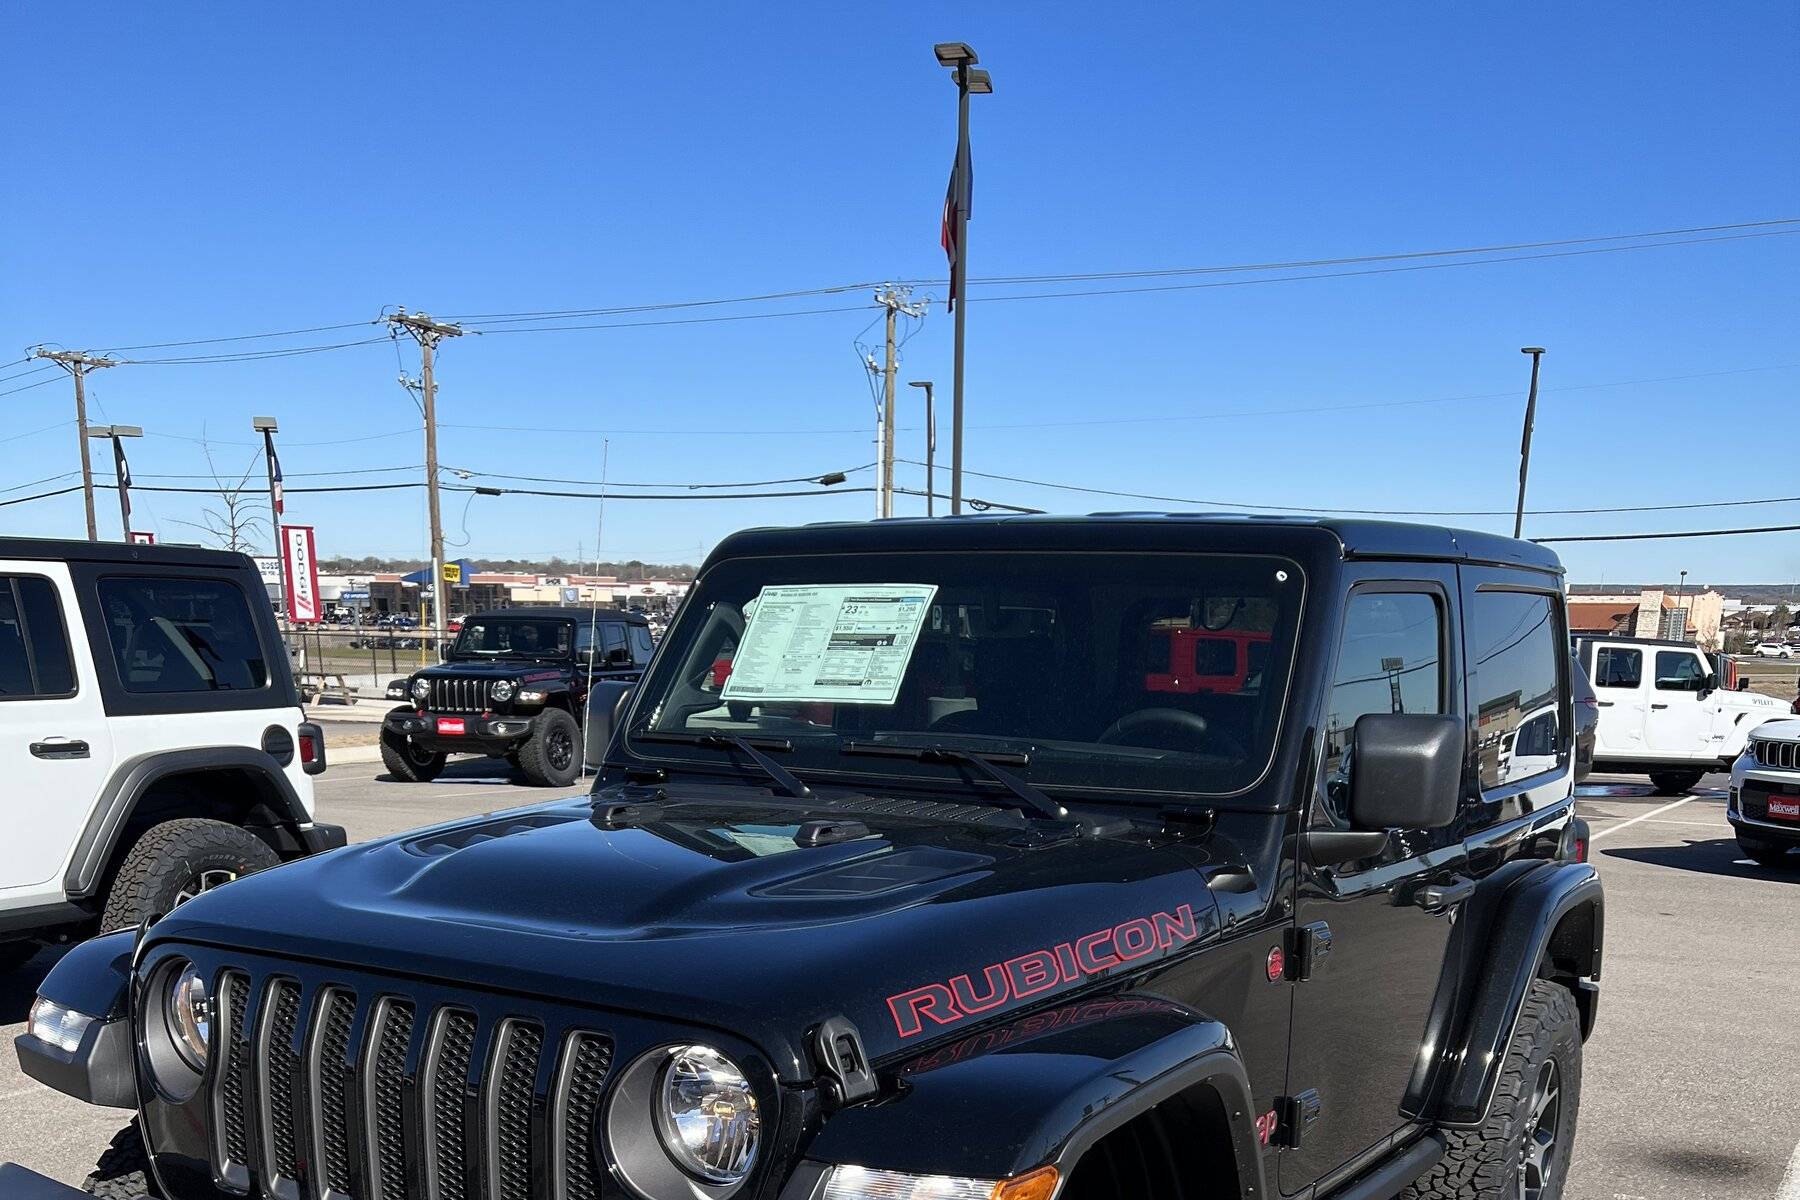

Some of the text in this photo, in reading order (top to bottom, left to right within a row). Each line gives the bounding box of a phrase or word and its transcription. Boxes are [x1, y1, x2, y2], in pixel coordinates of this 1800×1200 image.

[296, 533, 308, 600] DODGE
[845, 605, 859, 614] 23
[886, 904, 1198, 1038] RUBICON
